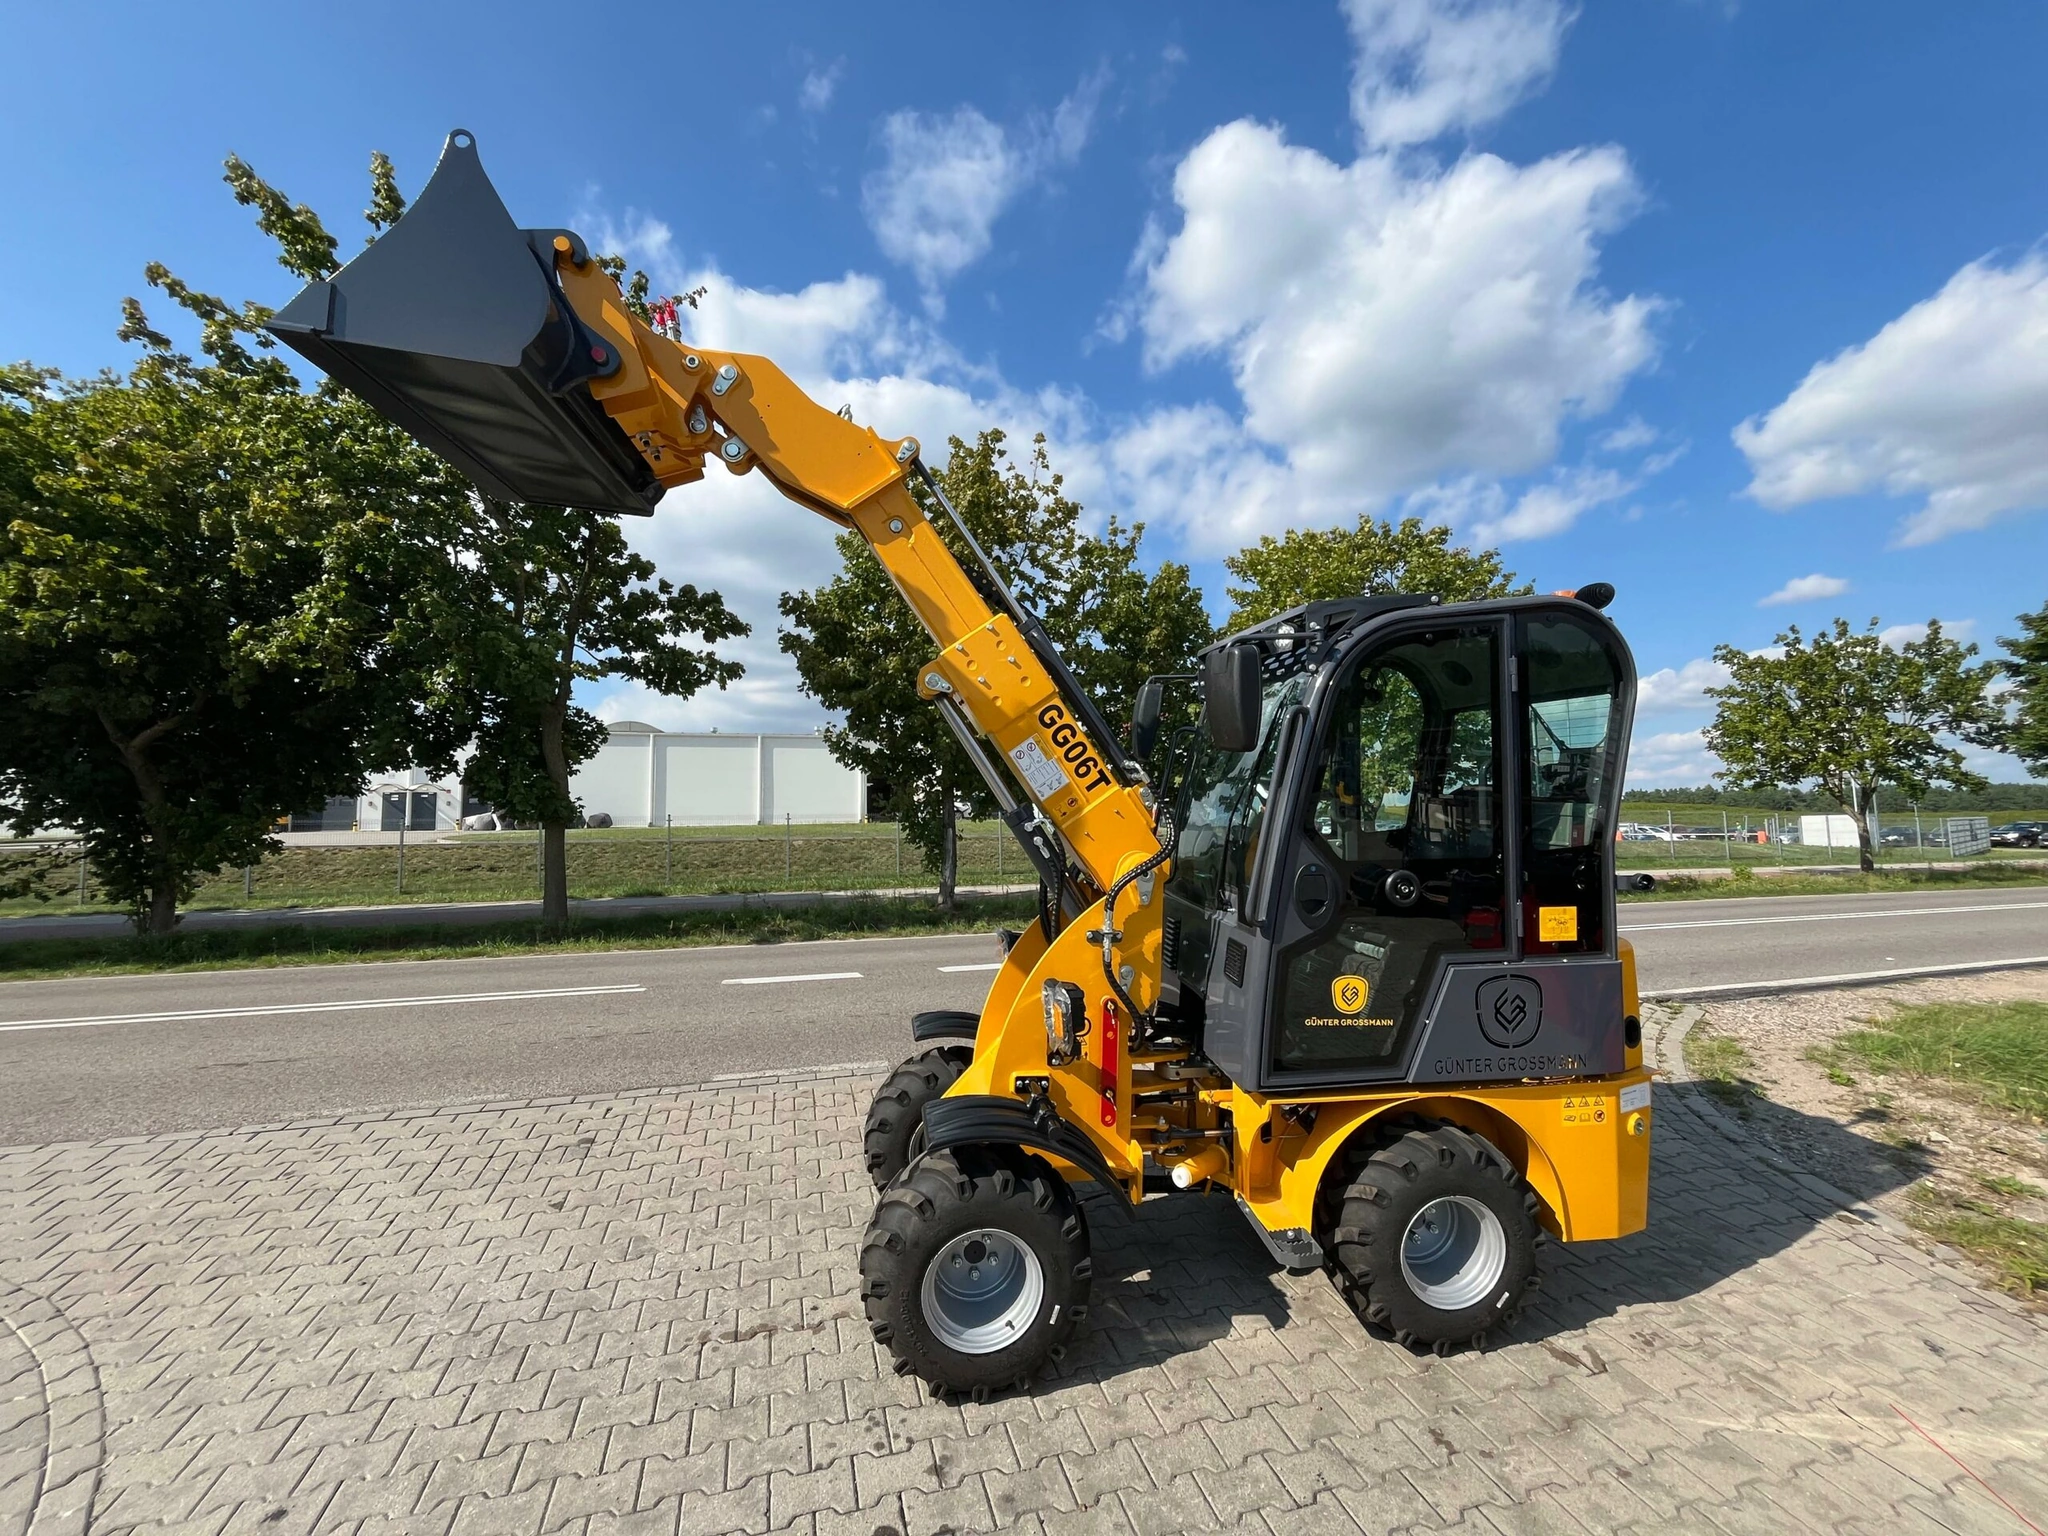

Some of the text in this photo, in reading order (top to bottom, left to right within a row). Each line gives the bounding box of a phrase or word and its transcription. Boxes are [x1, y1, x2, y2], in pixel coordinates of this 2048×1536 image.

[1038, 704, 1112, 793] GG06T
[1304, 1016, 1394, 1027] GÜNTER GROSSMANN
[1434, 1053, 1588, 1075] GÜNTER GROSSMANN
